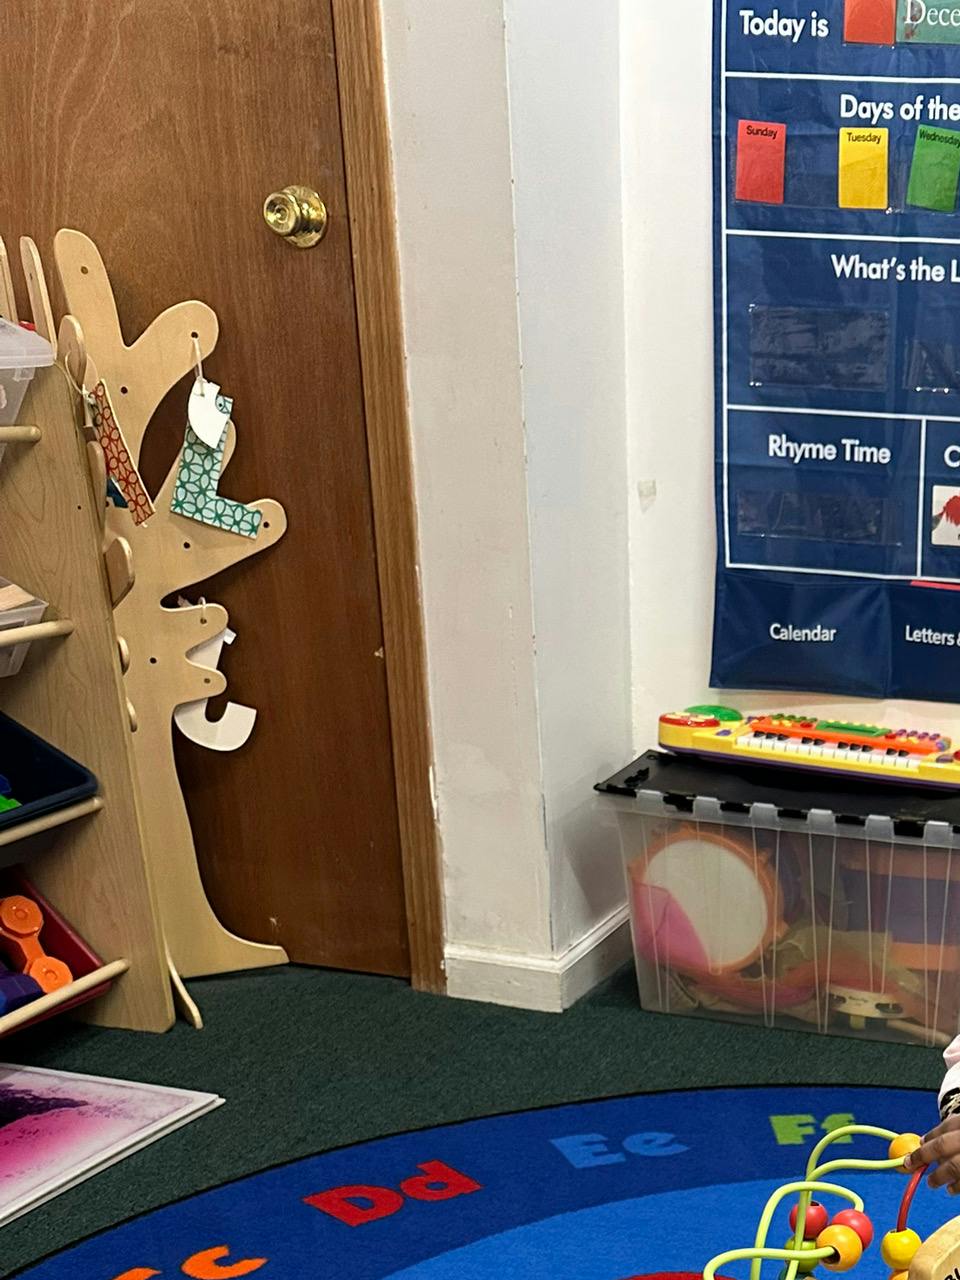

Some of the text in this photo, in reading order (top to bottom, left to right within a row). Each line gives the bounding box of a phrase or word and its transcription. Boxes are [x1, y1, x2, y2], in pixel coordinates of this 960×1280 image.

[739, 10, 829, 42] Today is
[840, 93, 894, 126] Days
[899, 96, 924, 121] of
[746, 125, 777, 140] Sunday
[846, 132, 881, 145] Tuesday
[831, 254, 905, 280] What's
[910, 257, 945, 281] the
[768, 434, 891, 464] Rhyme Time
[770, 623, 836, 642] Calendar
[905, 625, 954, 646] Letters
[550, 1132, 691, 1169] Ee
[303, 1161, 482, 1227] Dd
